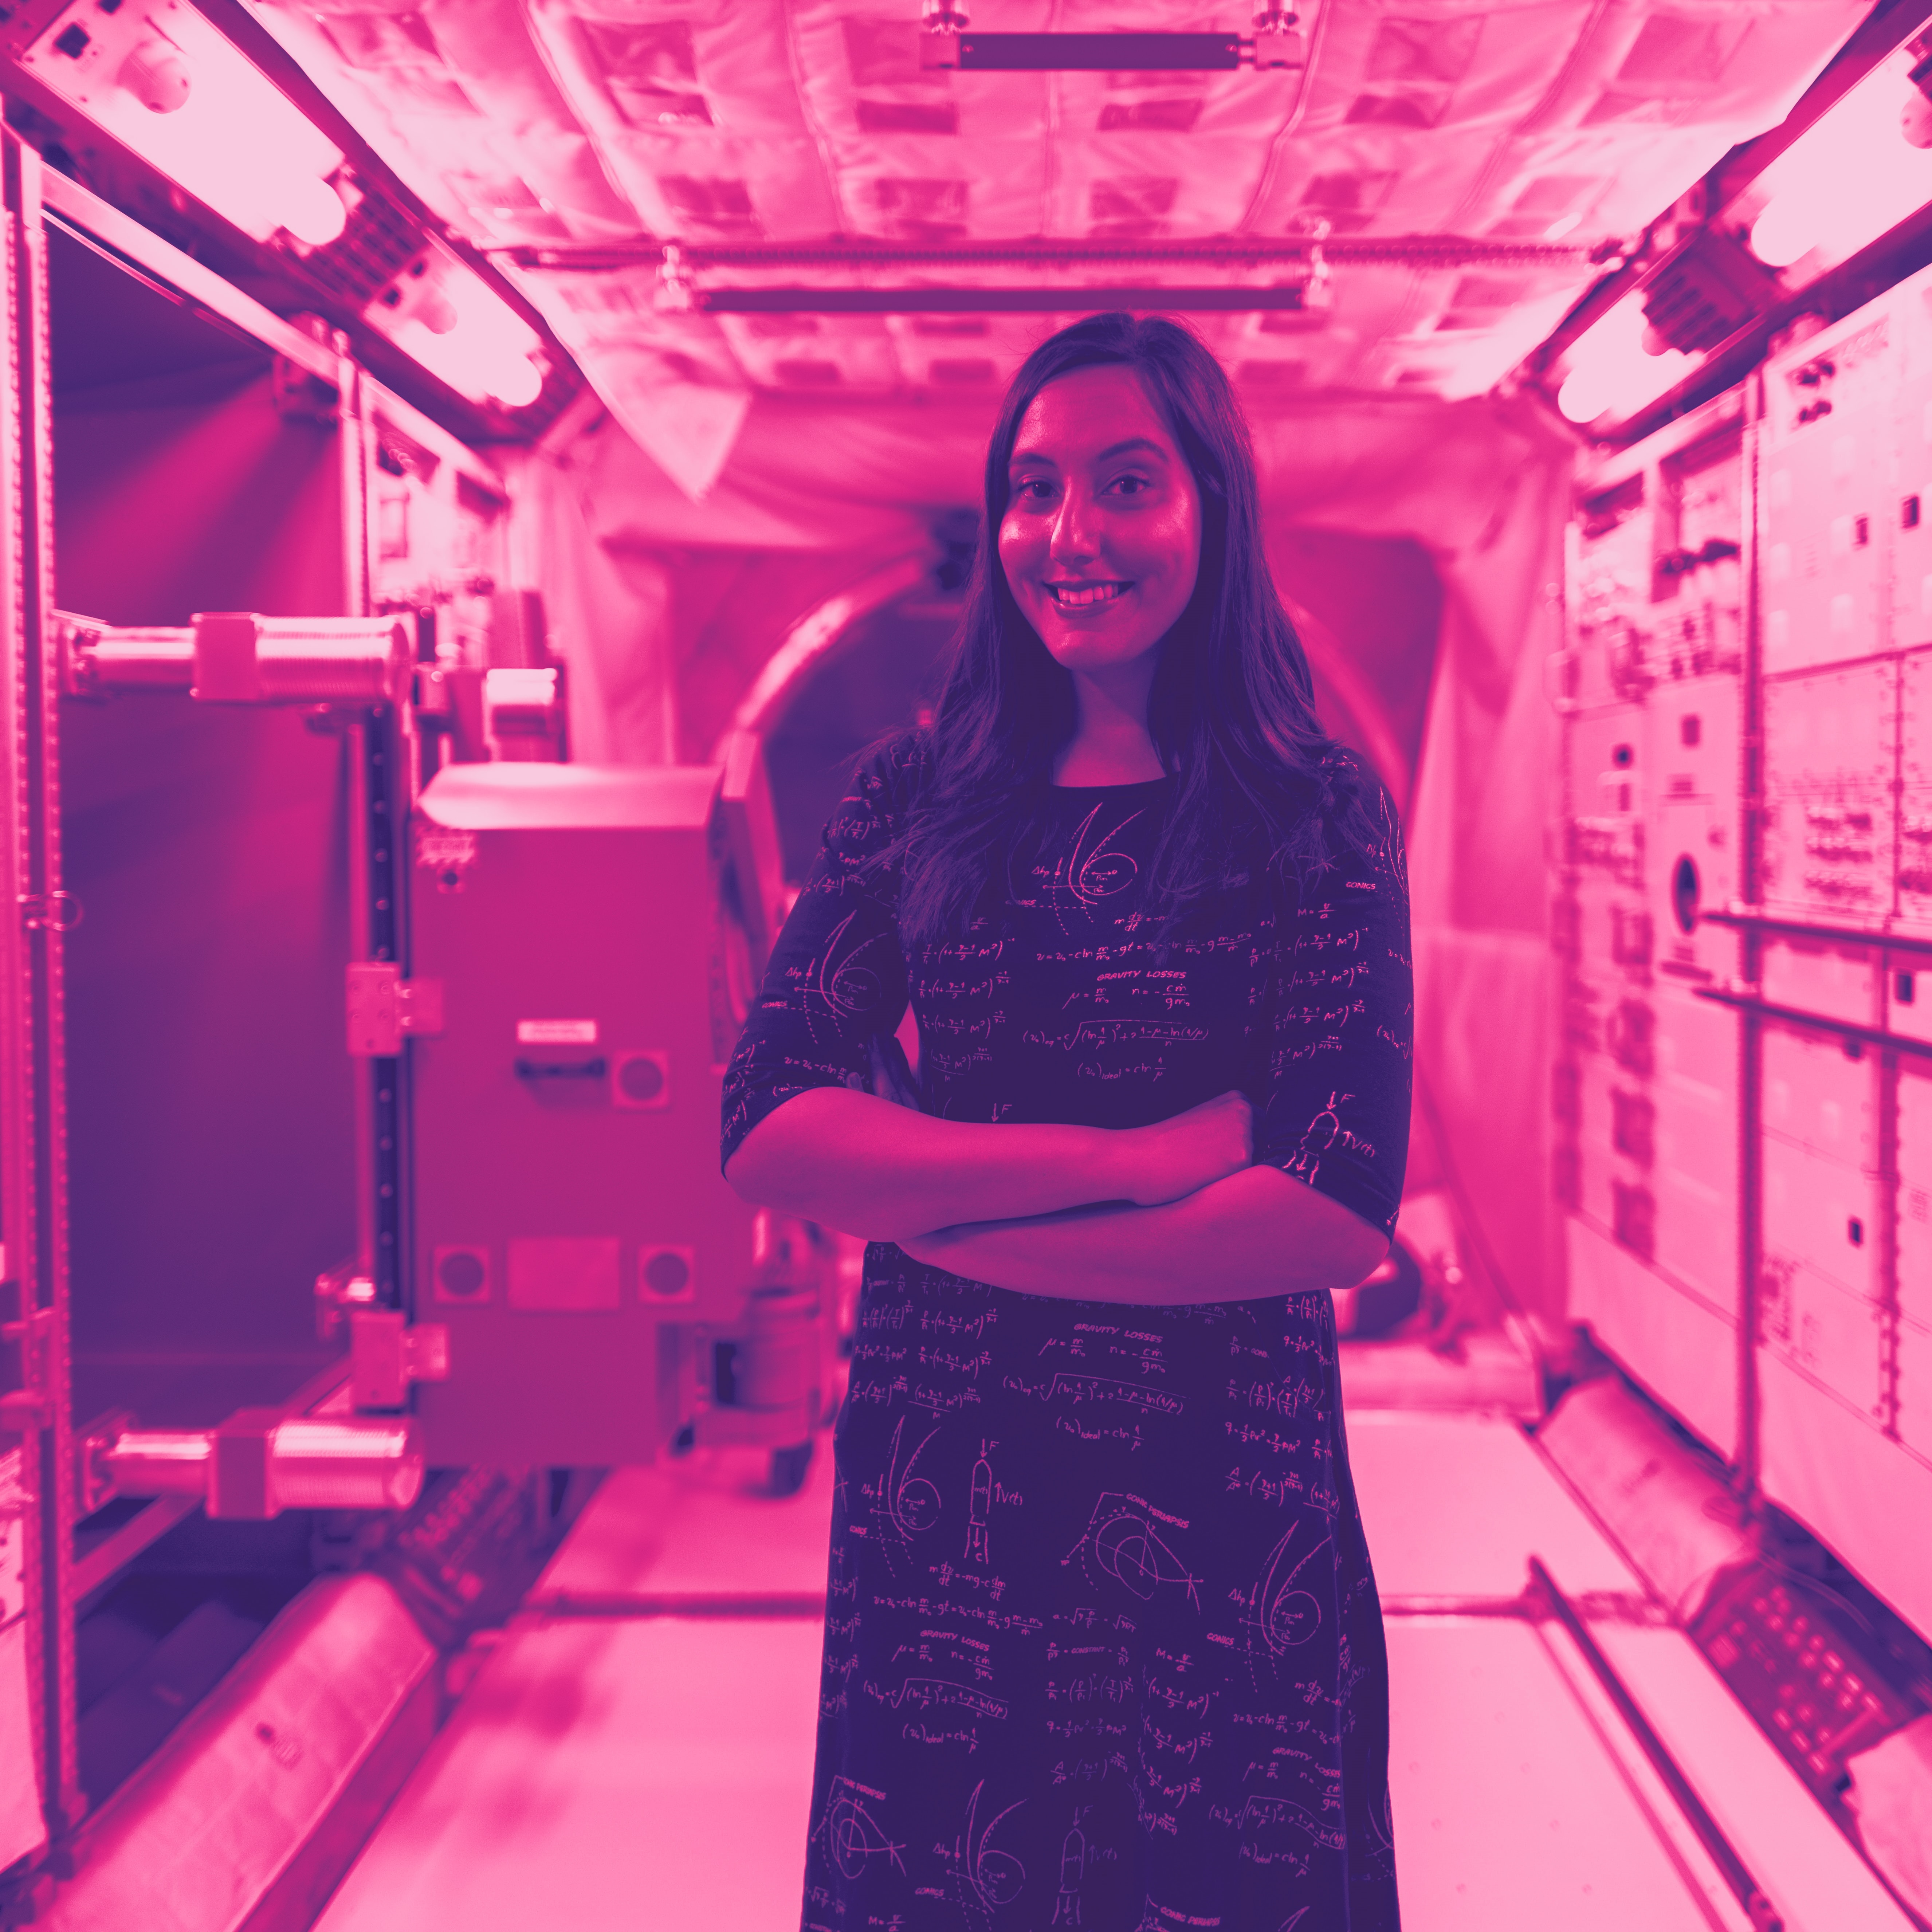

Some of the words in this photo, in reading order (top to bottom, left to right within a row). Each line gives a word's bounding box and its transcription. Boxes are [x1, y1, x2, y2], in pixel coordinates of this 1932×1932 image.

[1097, 970, 1141, 981] GRAVITY
[1074, 1323, 1119, 1334] GRAVITY
[1124, 1330, 1163, 1343] LOSSES
[1125, 1493, 1147, 1509] CONIC
[920, 1630, 958, 1640] GRAVITY
[962, 1637, 990, 1651] LOSSES
[1207, 1633, 1234, 1646] CONICS
[1272, 1747, 1312, 1760] GRAVITY
[915, 1887, 945, 1897] CONICS
